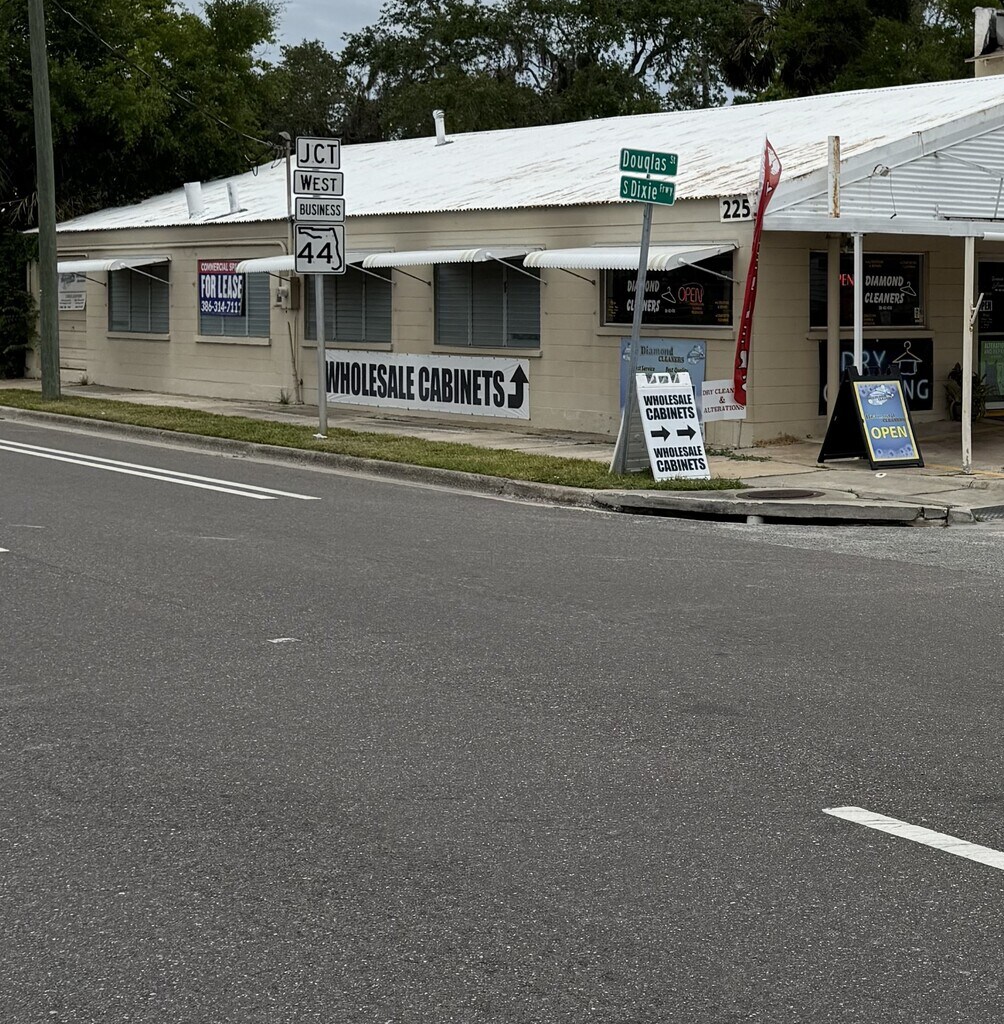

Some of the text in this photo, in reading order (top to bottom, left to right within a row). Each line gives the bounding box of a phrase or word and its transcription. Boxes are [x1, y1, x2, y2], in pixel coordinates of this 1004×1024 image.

[299, 143, 337, 164] JCT
[622, 150, 676, 174] Douglas St
[300, 174, 337, 192] WEST
[622, 180, 673, 200] S Dixie Frwy
[300, 203, 341, 216] BUSINESS
[722, 199, 751, 219] 225
[297, 241, 334, 264] 44
[201, 262, 229, 272] COMMERCIAL
[201, 274, 243, 299] FOR LEASE
[627, 280, 660, 293] DIAOND
[865, 276, 904, 287] DIAMOND
[678, 286, 703, 303] OPEN
[864, 292, 905, 304] CLEANERS
[640, 346, 674, 356] Diamond
[658, 355, 685, 364] CLEANERS
[325, 361, 505, 408] WHOLESALE CABINETS
[714, 387, 735, 395] CLEAN
[643, 394, 693, 406] WHOLESALE
[719, 396, 725, 404] &
[645, 406, 695, 421] CABINETS
[704, 404, 745, 414] ALTERATIONS
[870, 425, 908, 439] OPEN
[653, 445, 703, 458] WHOLESALE
[656, 457, 706, 473] CABINETS
